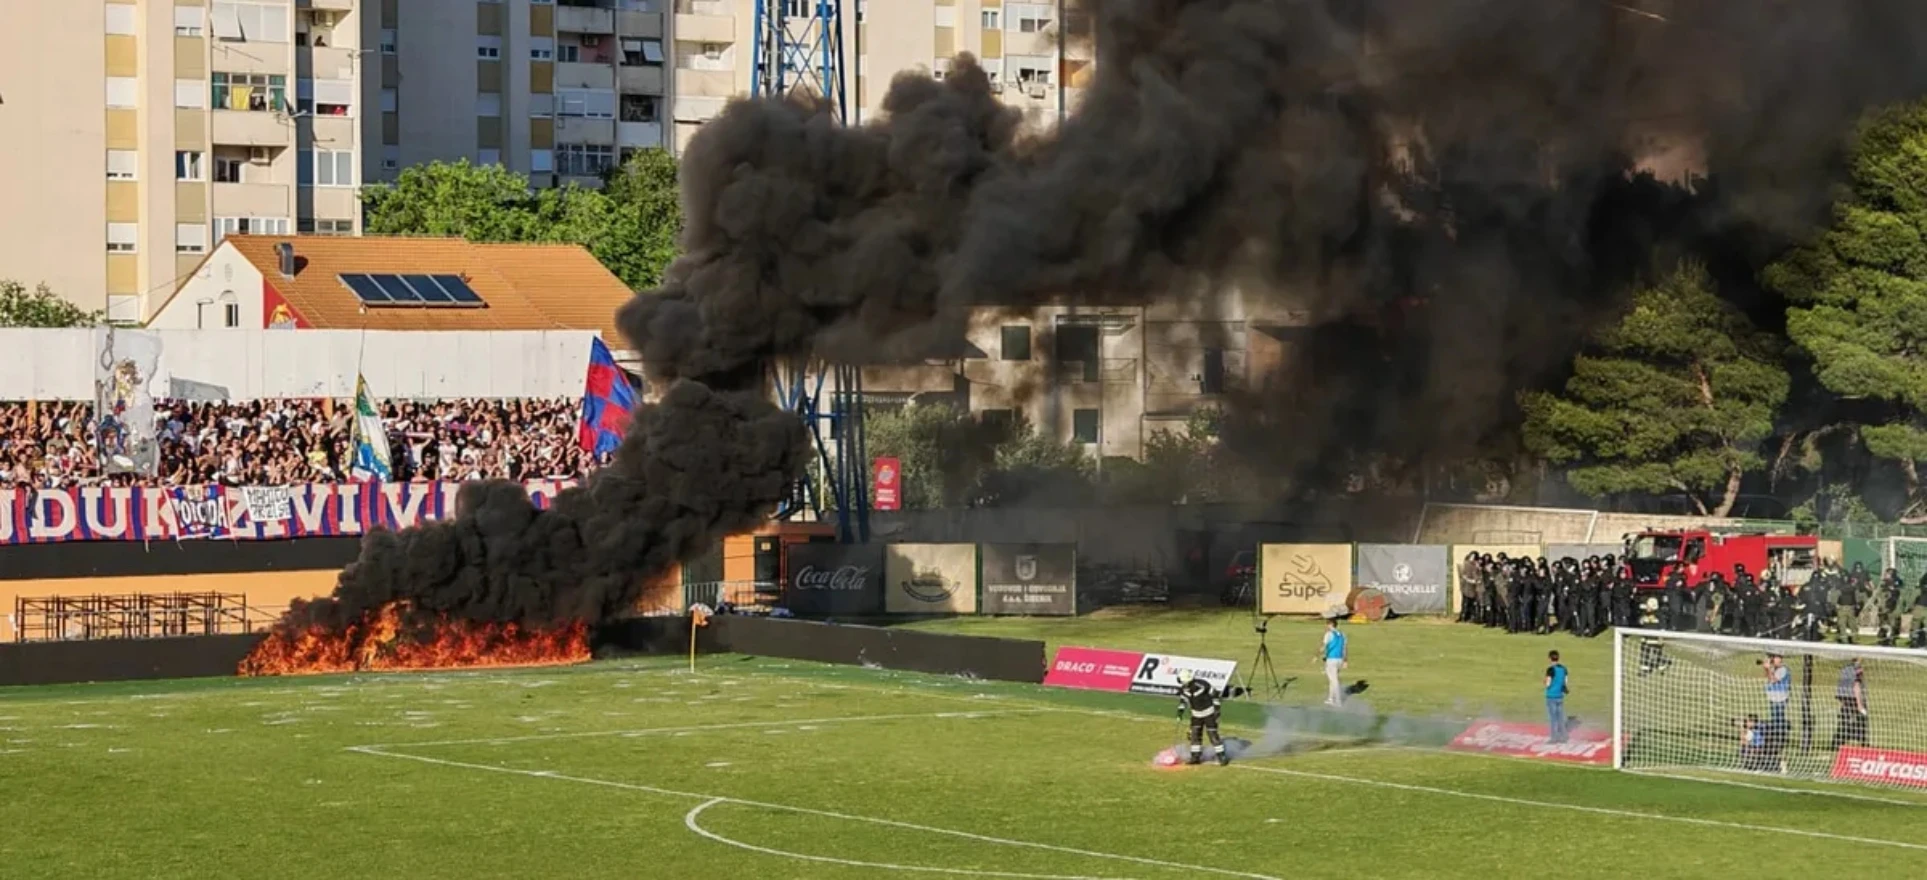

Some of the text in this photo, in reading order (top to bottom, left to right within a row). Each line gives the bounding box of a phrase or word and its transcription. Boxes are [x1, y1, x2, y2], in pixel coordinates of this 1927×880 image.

[1056, 660, 1095, 674] DRACO
[1137, 657, 1160, 680] R
[1860, 753, 1927, 780] aircas
